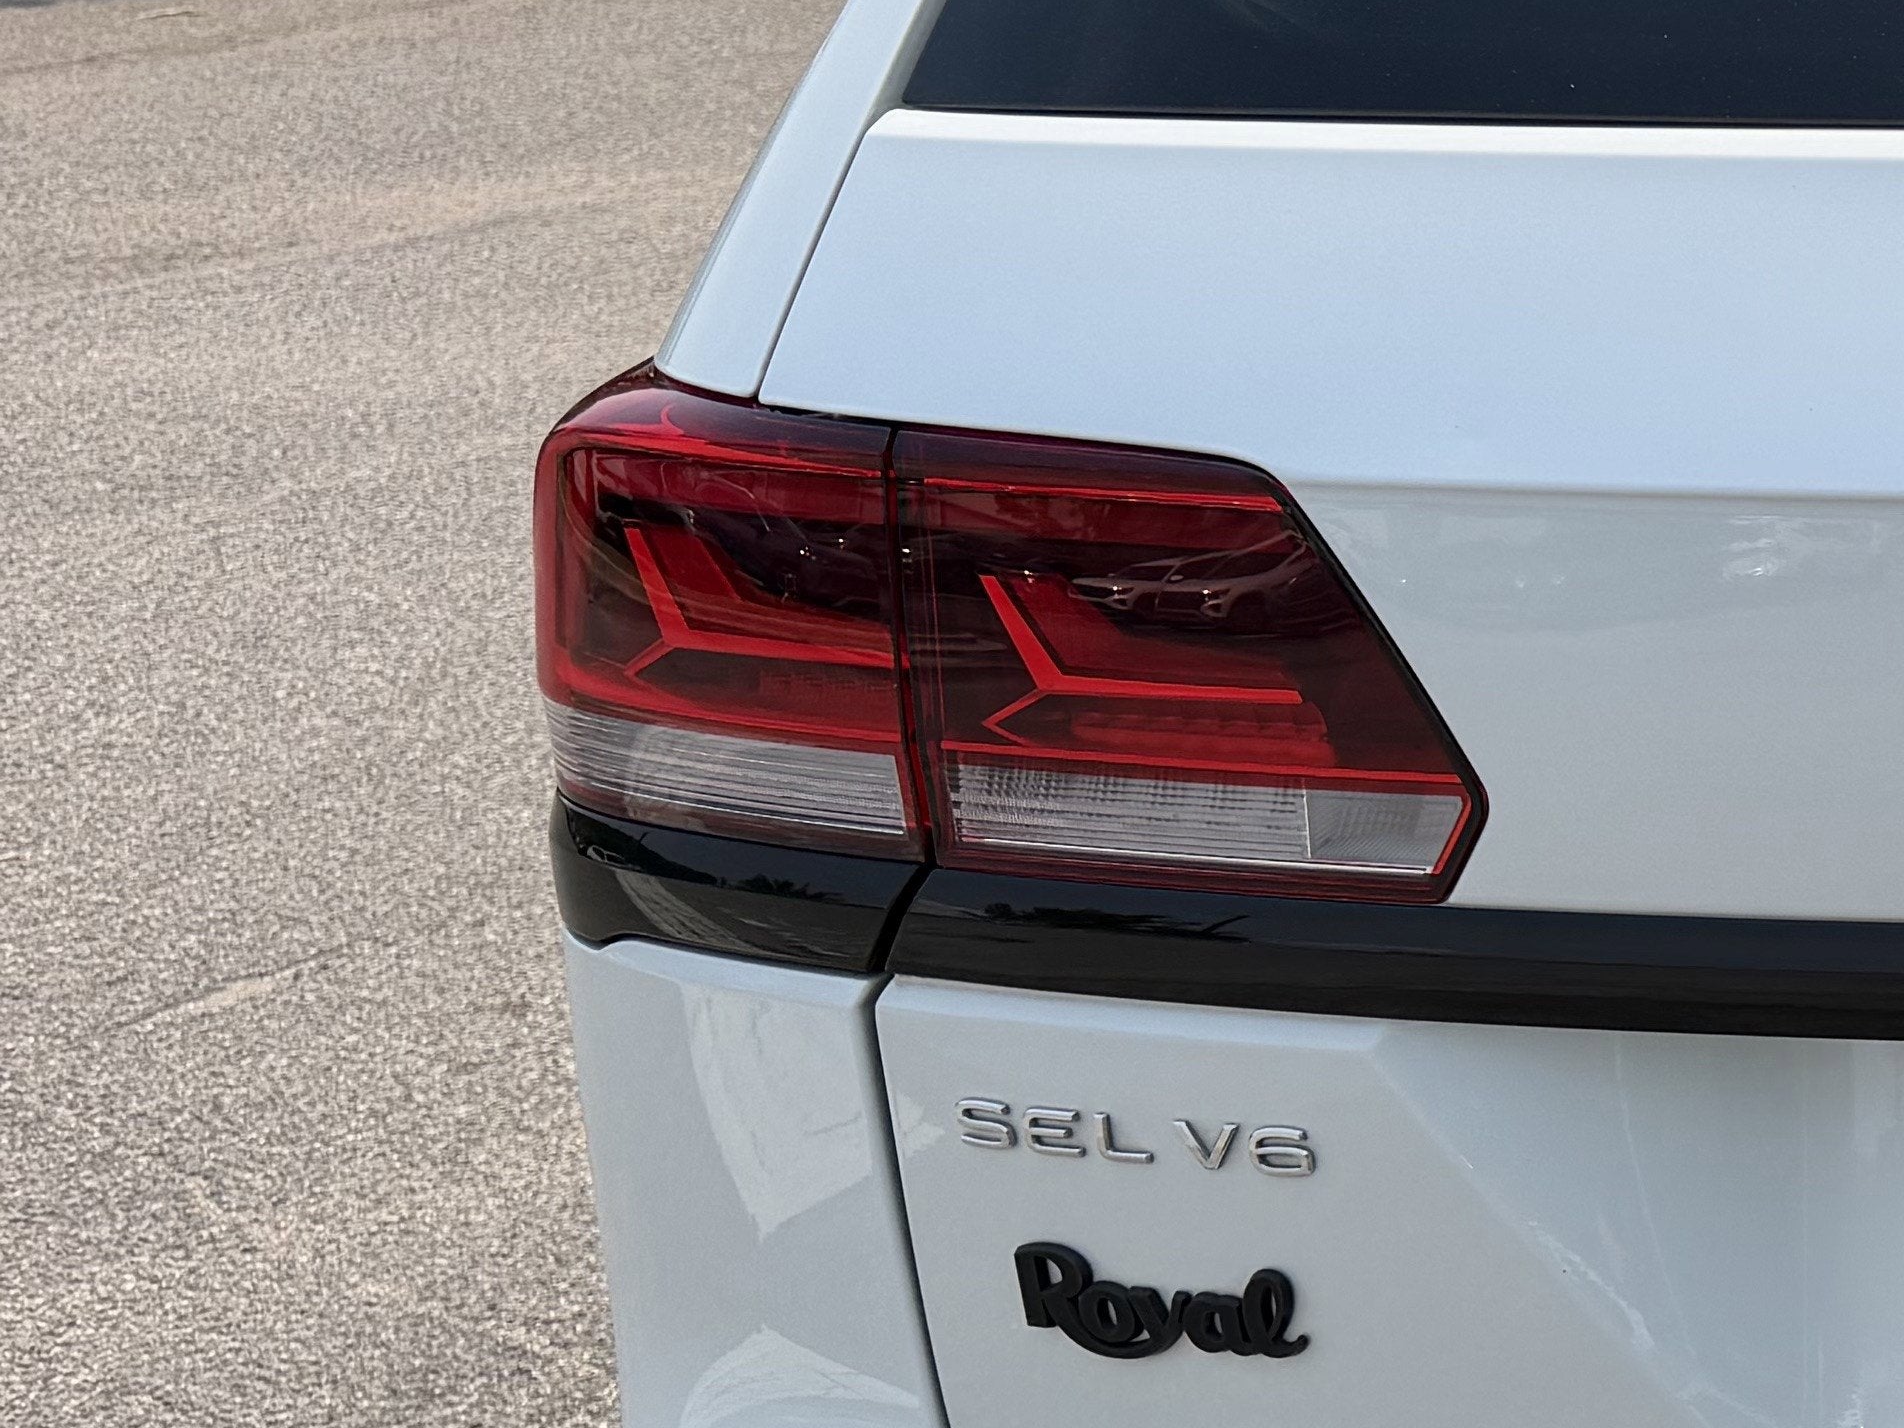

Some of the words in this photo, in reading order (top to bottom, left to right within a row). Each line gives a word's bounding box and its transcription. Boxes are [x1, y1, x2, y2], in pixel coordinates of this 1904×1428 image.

[955, 1096, 1155, 1164] SEL
[1172, 1118, 1317, 1177] V6
[1013, 1241, 1311, 1360] Royal
